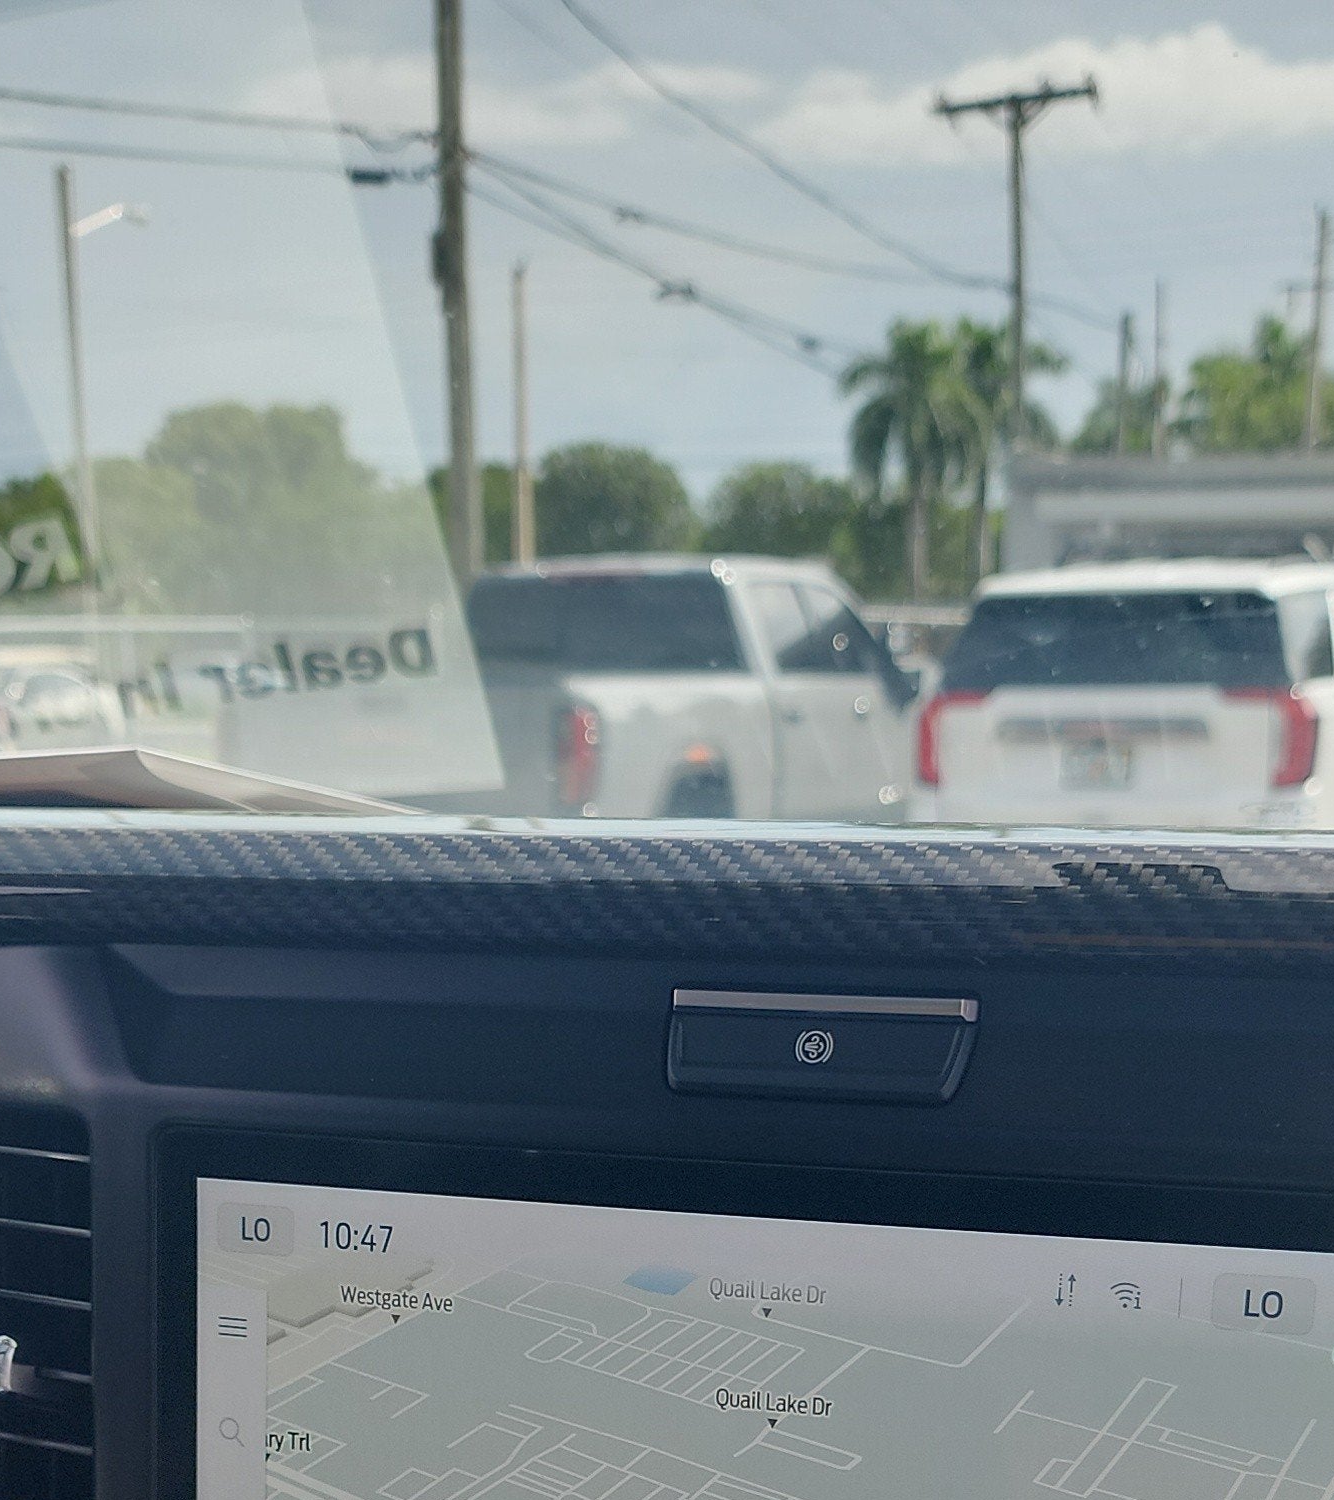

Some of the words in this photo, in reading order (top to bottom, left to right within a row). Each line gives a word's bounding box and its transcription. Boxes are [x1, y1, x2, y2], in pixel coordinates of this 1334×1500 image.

[240, 1216, 272, 1243] LO
[318, 1219, 394, 1254] 10:47
[339, 1284, 417, 1311] Westgate
[418, 1291, 454, 1312] Ave
[708, 1277, 754, 1300] Quail
[759, 1280, 801, 1303] Lake
[805, 1284, 827, 1304] Dr
[1243, 1288, 1285, 1319] LO
[715, 1387, 761, 1411] Quail
[766, 1391, 807, 1415] Lake
[812, 1396, 833, 1418] Dr
[265, 1434, 284, 1452] ry
[287, 1431, 311, 1451] Trl
